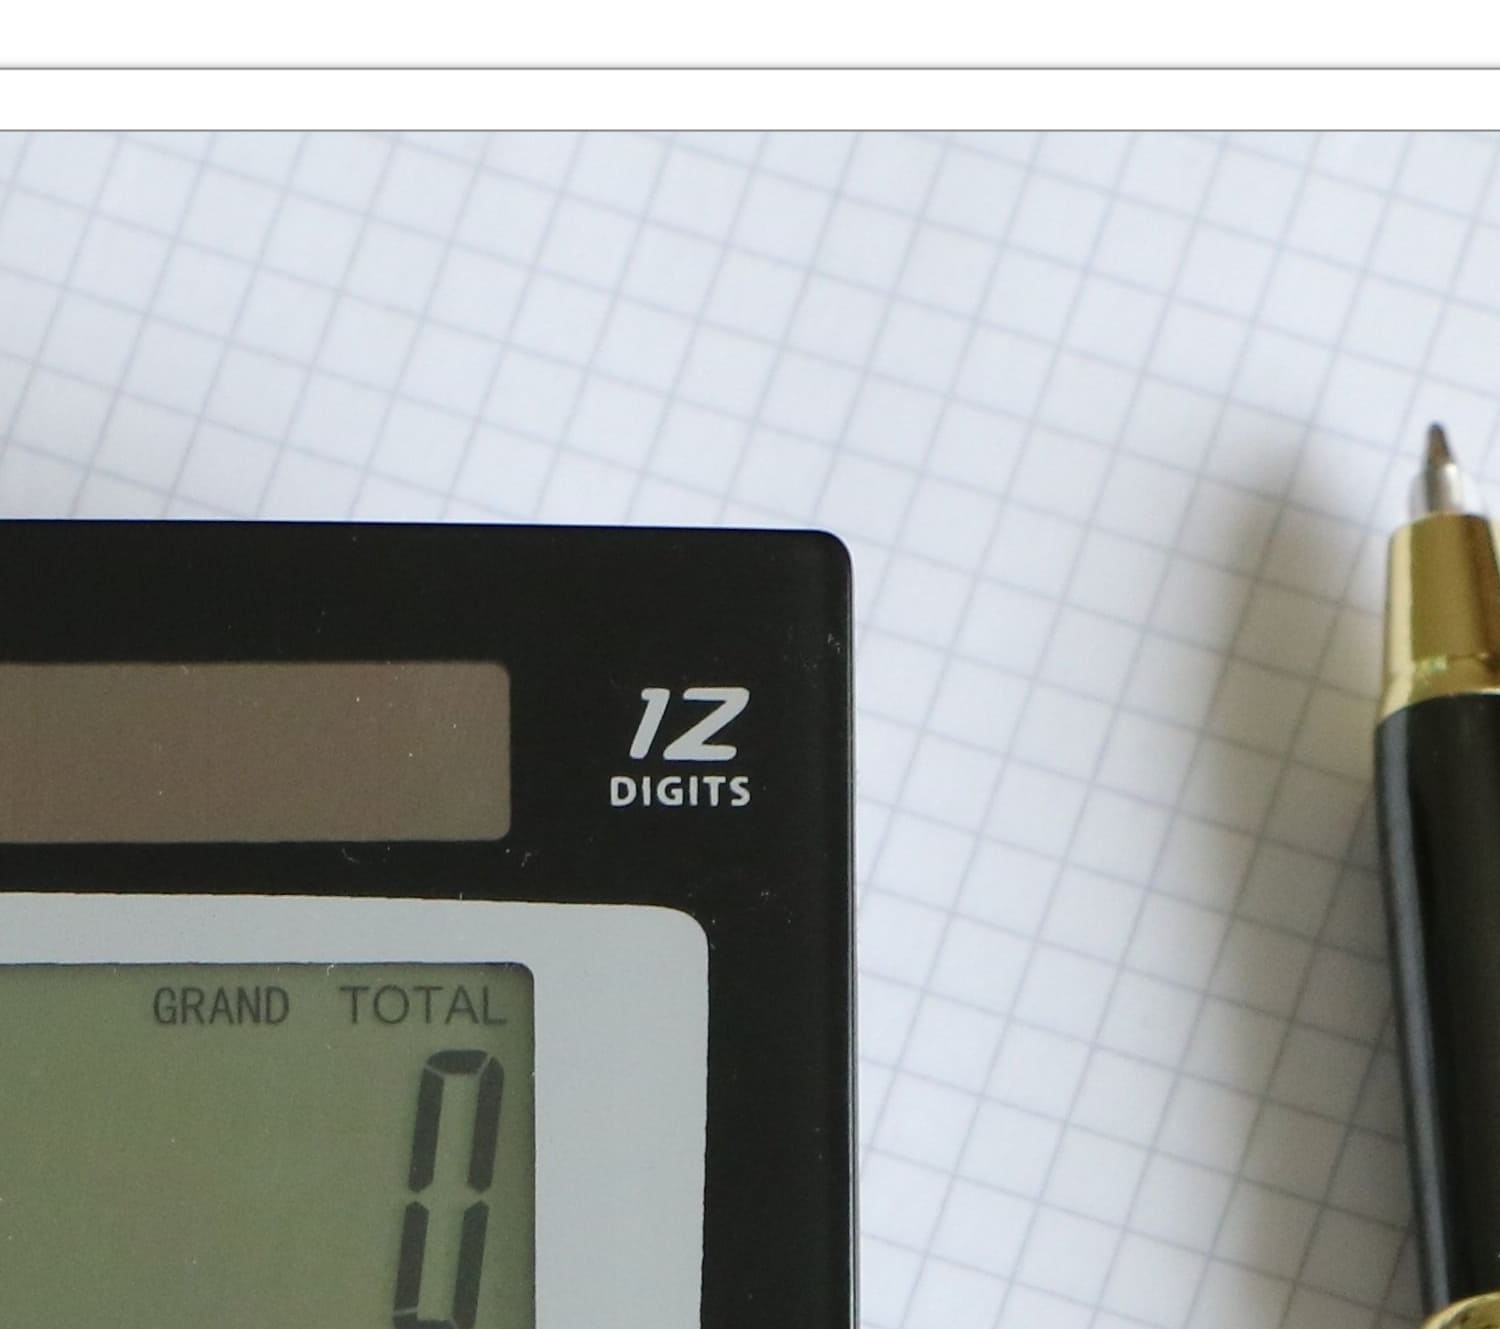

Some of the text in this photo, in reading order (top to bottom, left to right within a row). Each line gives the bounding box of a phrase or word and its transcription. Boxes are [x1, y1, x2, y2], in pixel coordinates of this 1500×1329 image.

[609, 775, 751, 807] DIGITS
[152, 986, 508, 1026] GRAND TOTAL
